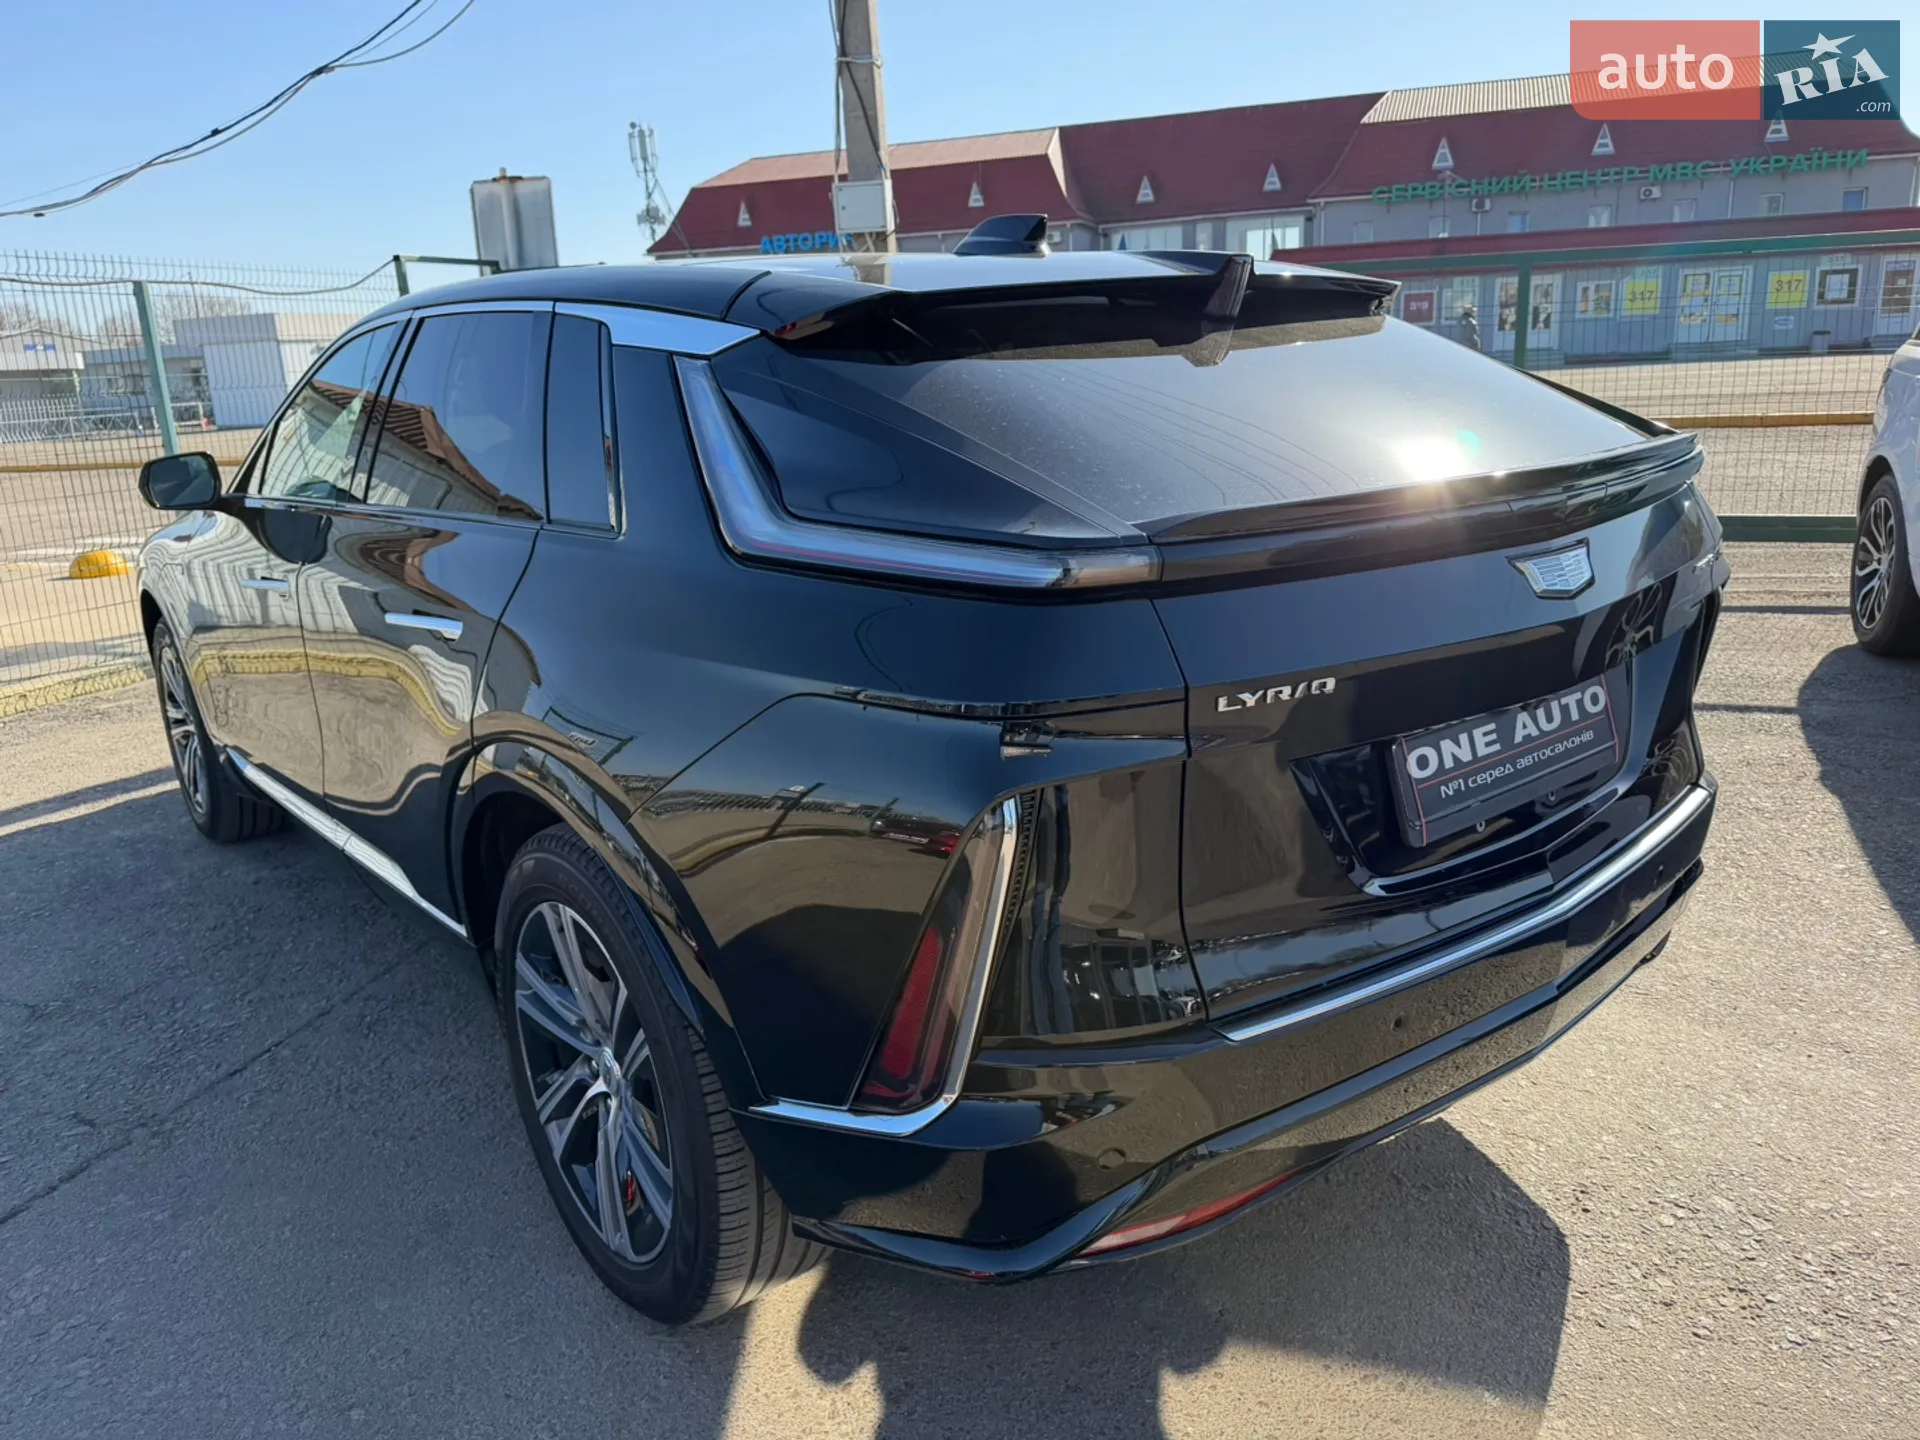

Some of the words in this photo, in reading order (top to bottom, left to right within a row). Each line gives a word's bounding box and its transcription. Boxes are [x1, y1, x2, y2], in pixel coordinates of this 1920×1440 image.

[1372, 169, 1532, 204] СЕРВСНИЙ
[1543, 166, 1639, 192] ЦЕНТР
[1649, 161, 1713, 183] МВС
[1728, 147, 1869, 177] УКРАЇНИ
[1628, 289, 1655, 303] 317
[1775, 278, 1803, 293] 317
[1408, 722, 1501, 779] ONE
[1513, 685, 1606, 743] AUTO
[1468, 763, 1515, 789] серед
[1516, 729, 1594, 769] автосалонів
